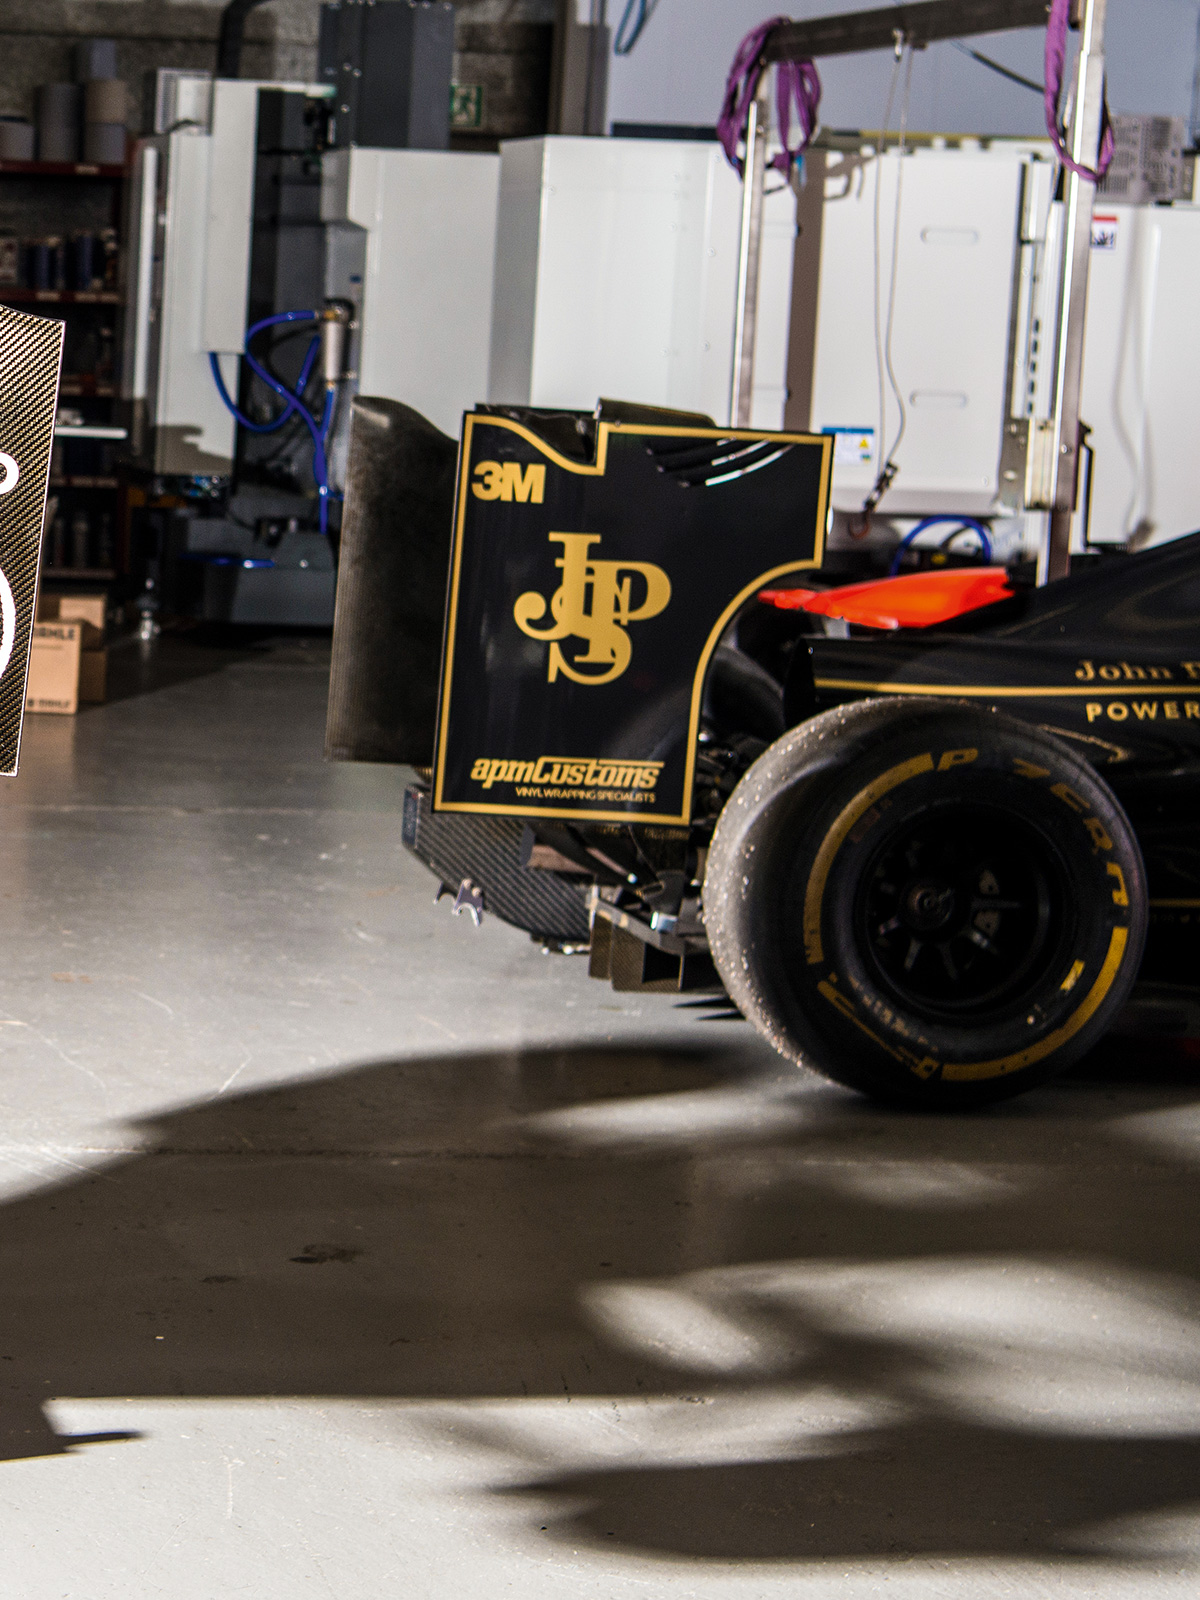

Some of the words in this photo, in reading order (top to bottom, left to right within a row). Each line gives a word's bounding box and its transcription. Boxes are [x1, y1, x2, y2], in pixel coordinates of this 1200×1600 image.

[472, 461, 546, 504] 3M
[1075, 660, 1174, 681] John
[1085, 700, 1200, 723] POWER
[470, 755, 665, 790] apmCustoms
[516, 787, 543, 798] VINYL
[543, 787, 596, 801] WRAPPING
[596, 790, 656, 804] SPECIALISTS
